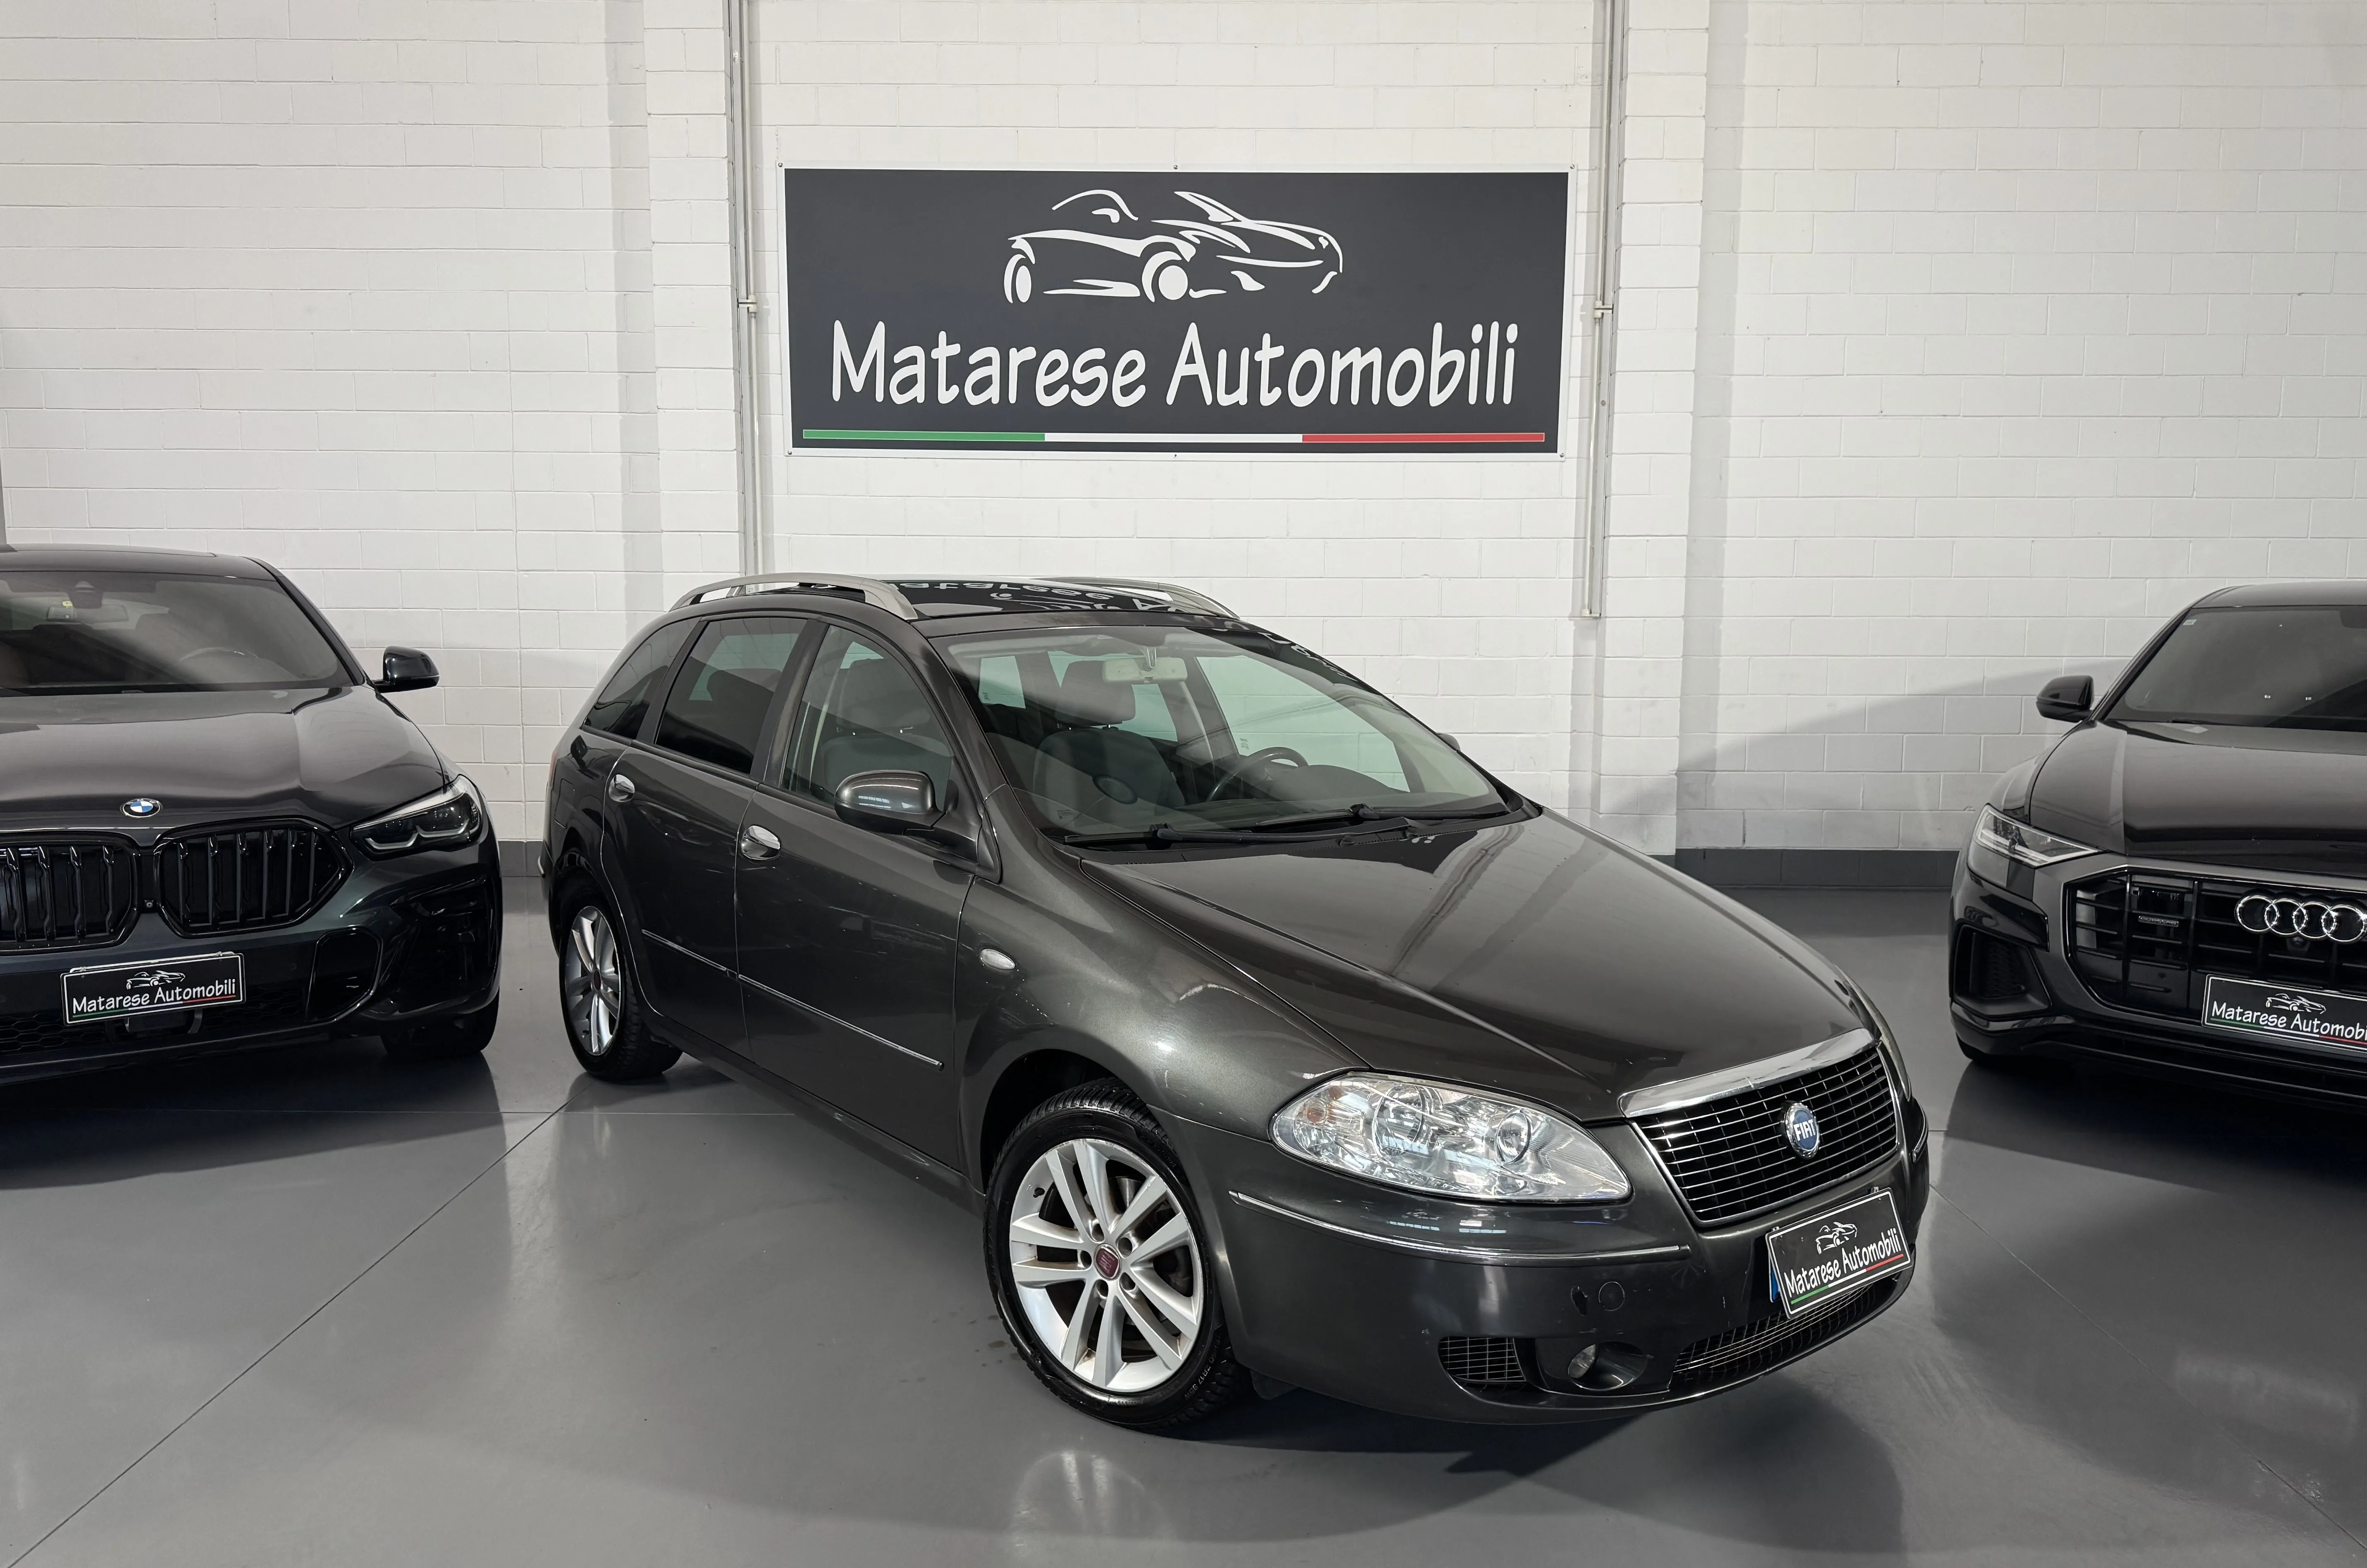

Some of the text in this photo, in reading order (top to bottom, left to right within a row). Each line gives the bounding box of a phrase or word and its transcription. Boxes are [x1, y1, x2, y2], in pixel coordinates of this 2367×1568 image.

[833, 320, 1517, 407] Matarese Automobili
[73, 978, 235, 1014] Matarese Automobili
[2212, 1001, 2287, 1028] Matarese
[1793, 1119, 1815, 1141] FIAT
[1784, 1228, 1901, 1298] Matarese Automobili
